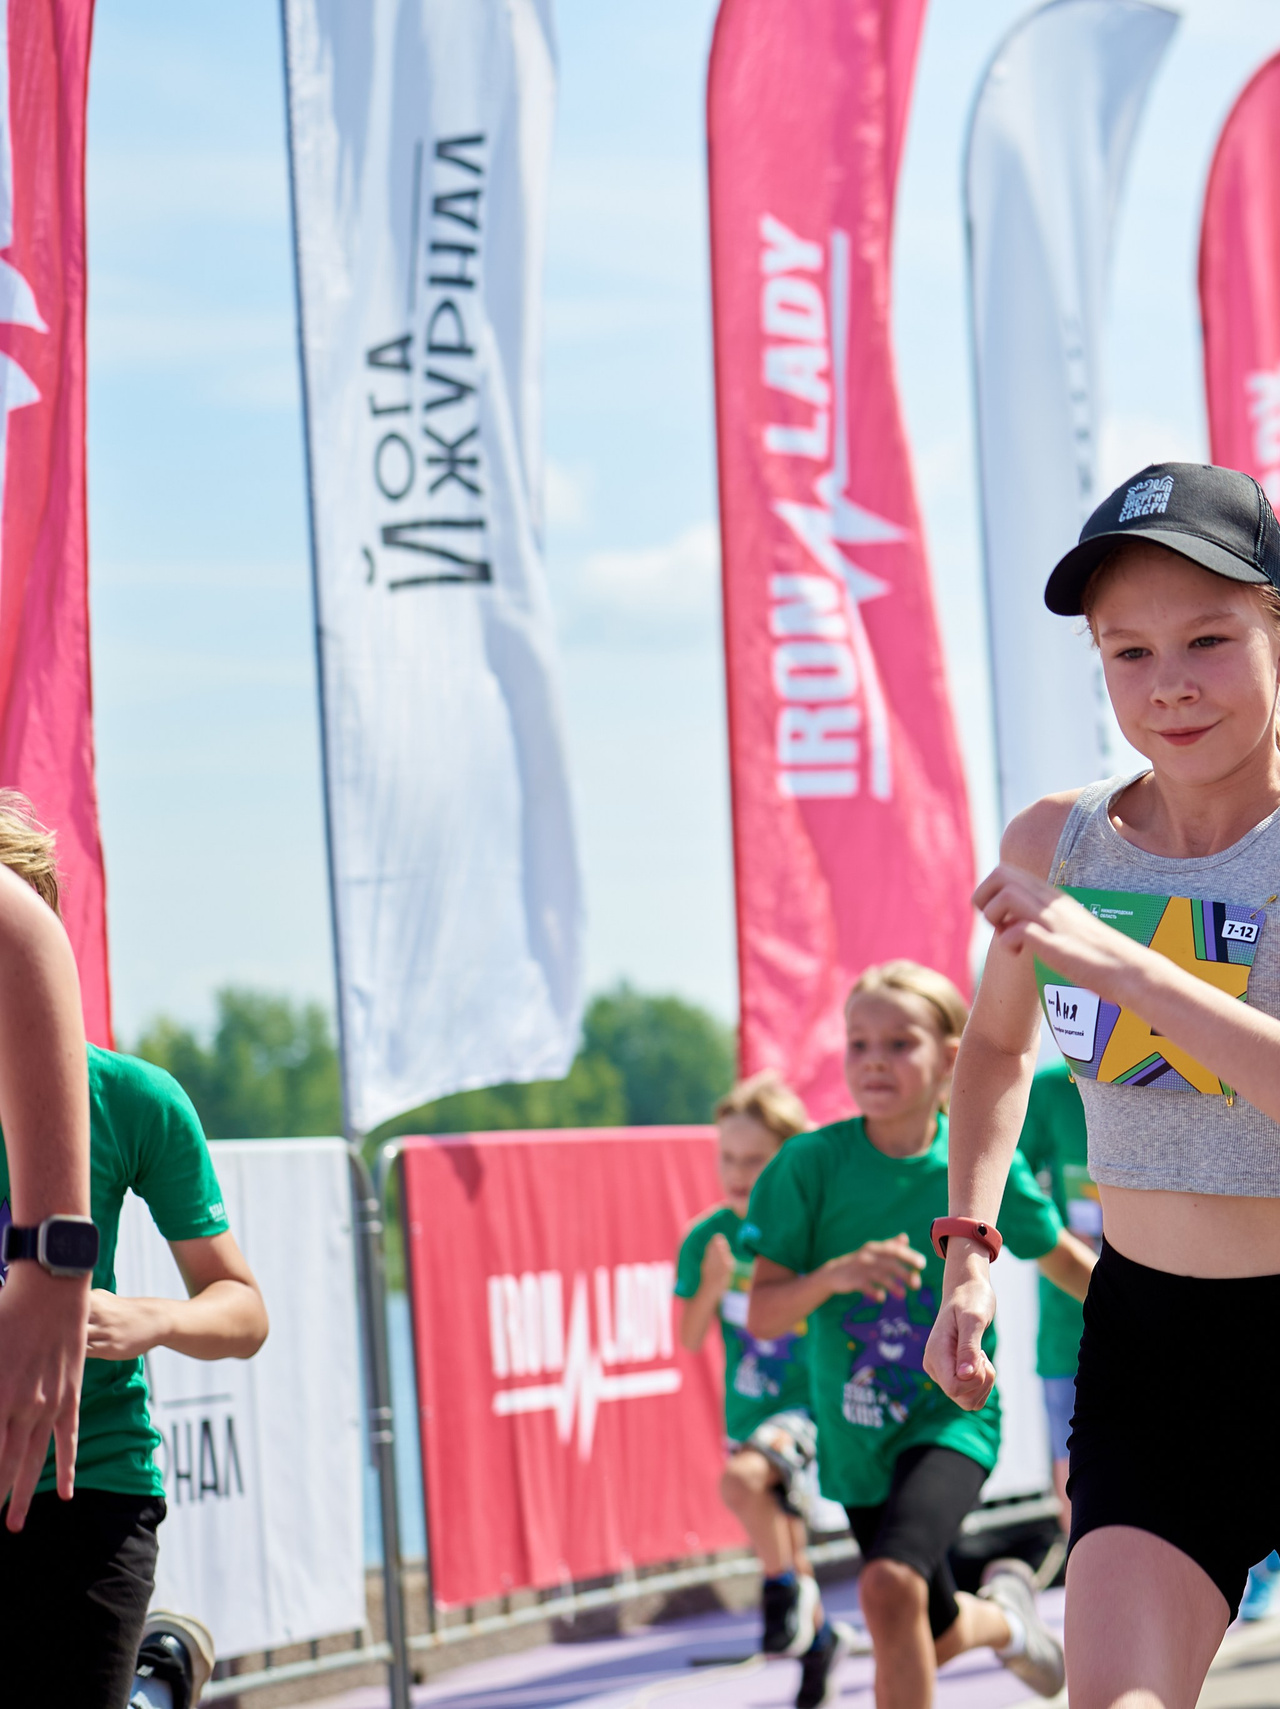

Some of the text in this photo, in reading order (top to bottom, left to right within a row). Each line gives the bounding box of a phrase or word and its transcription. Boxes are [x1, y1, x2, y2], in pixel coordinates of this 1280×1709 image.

[760, 211, 861, 799] IRON LADY
[1118, 501, 1168, 523] СЕВЕРА
[1227, 923, 1254, 939] 7-12
[594, 1259, 675, 1366] LADY
